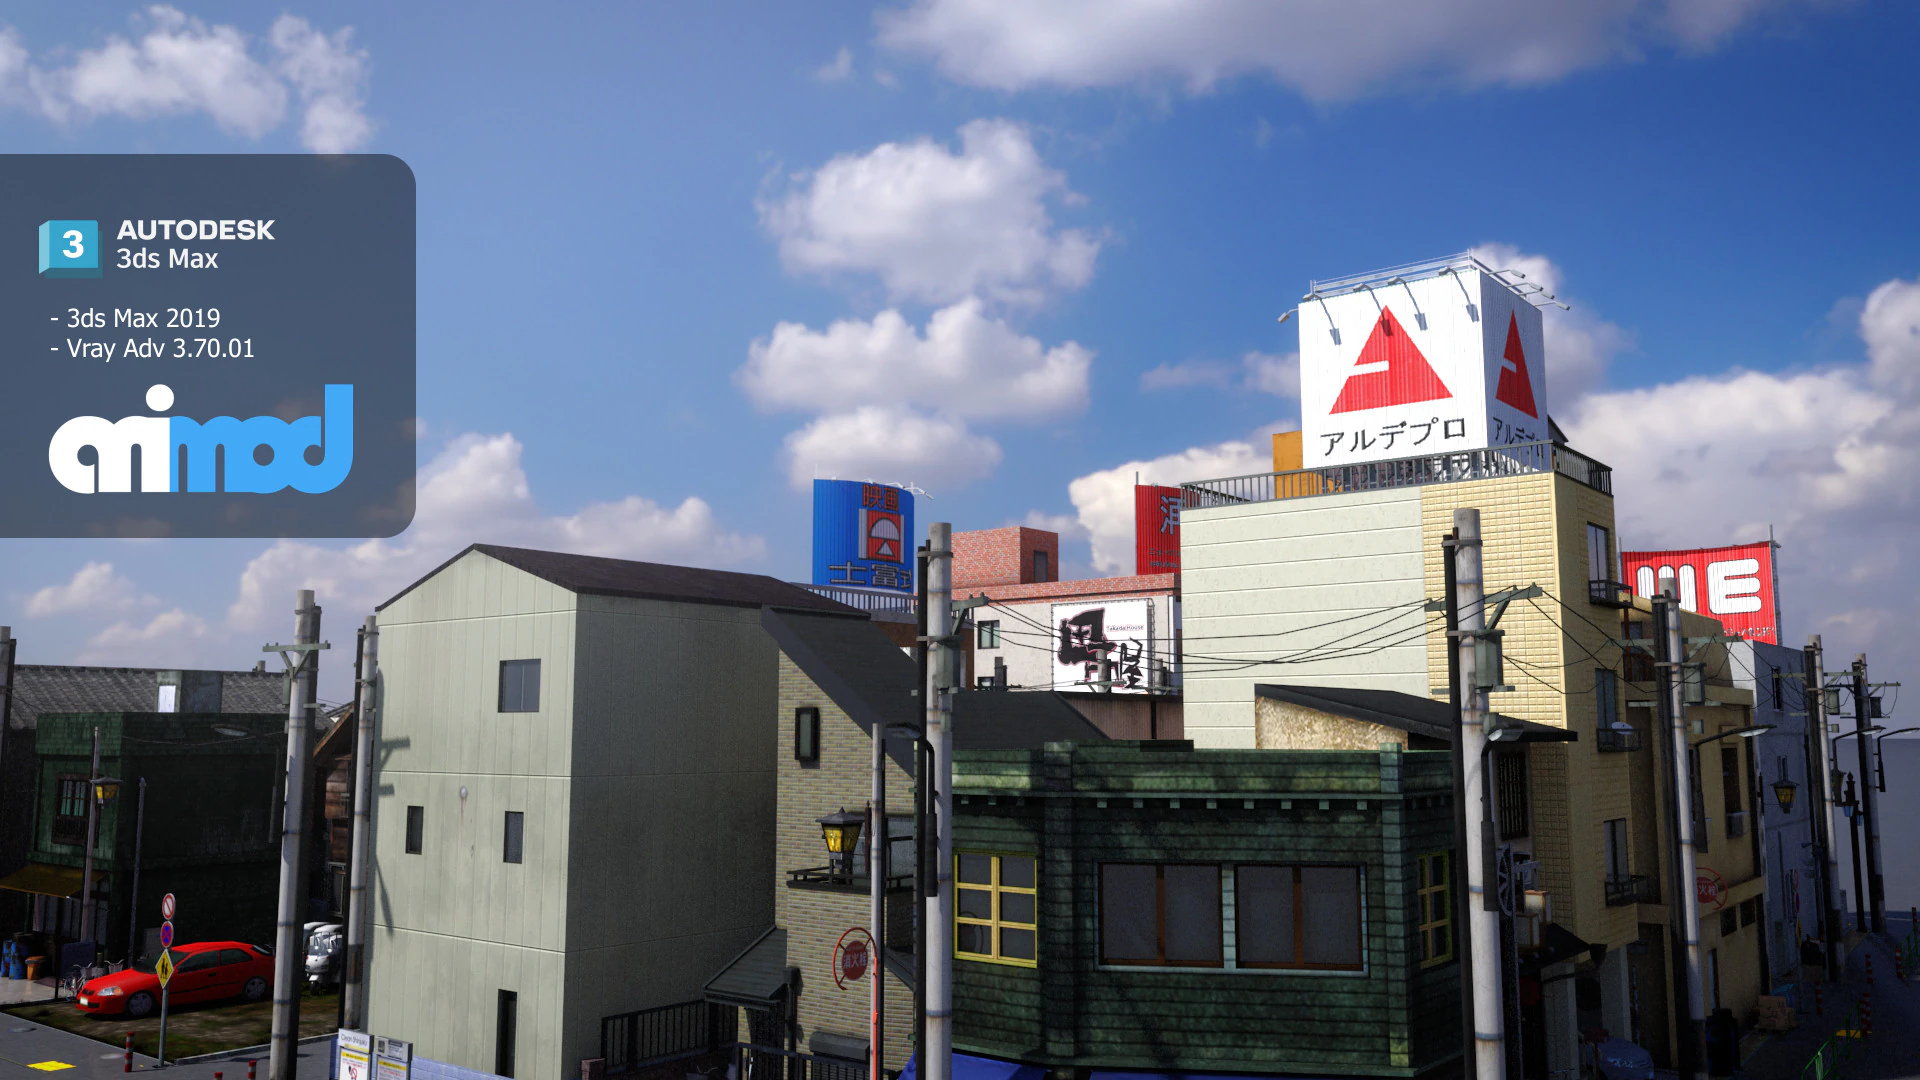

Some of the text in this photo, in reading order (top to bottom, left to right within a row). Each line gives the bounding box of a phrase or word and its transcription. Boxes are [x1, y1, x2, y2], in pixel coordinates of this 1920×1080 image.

[1320, 416, 1466, 457] アルデプロ
[862, 484, 900, 512] 映画
